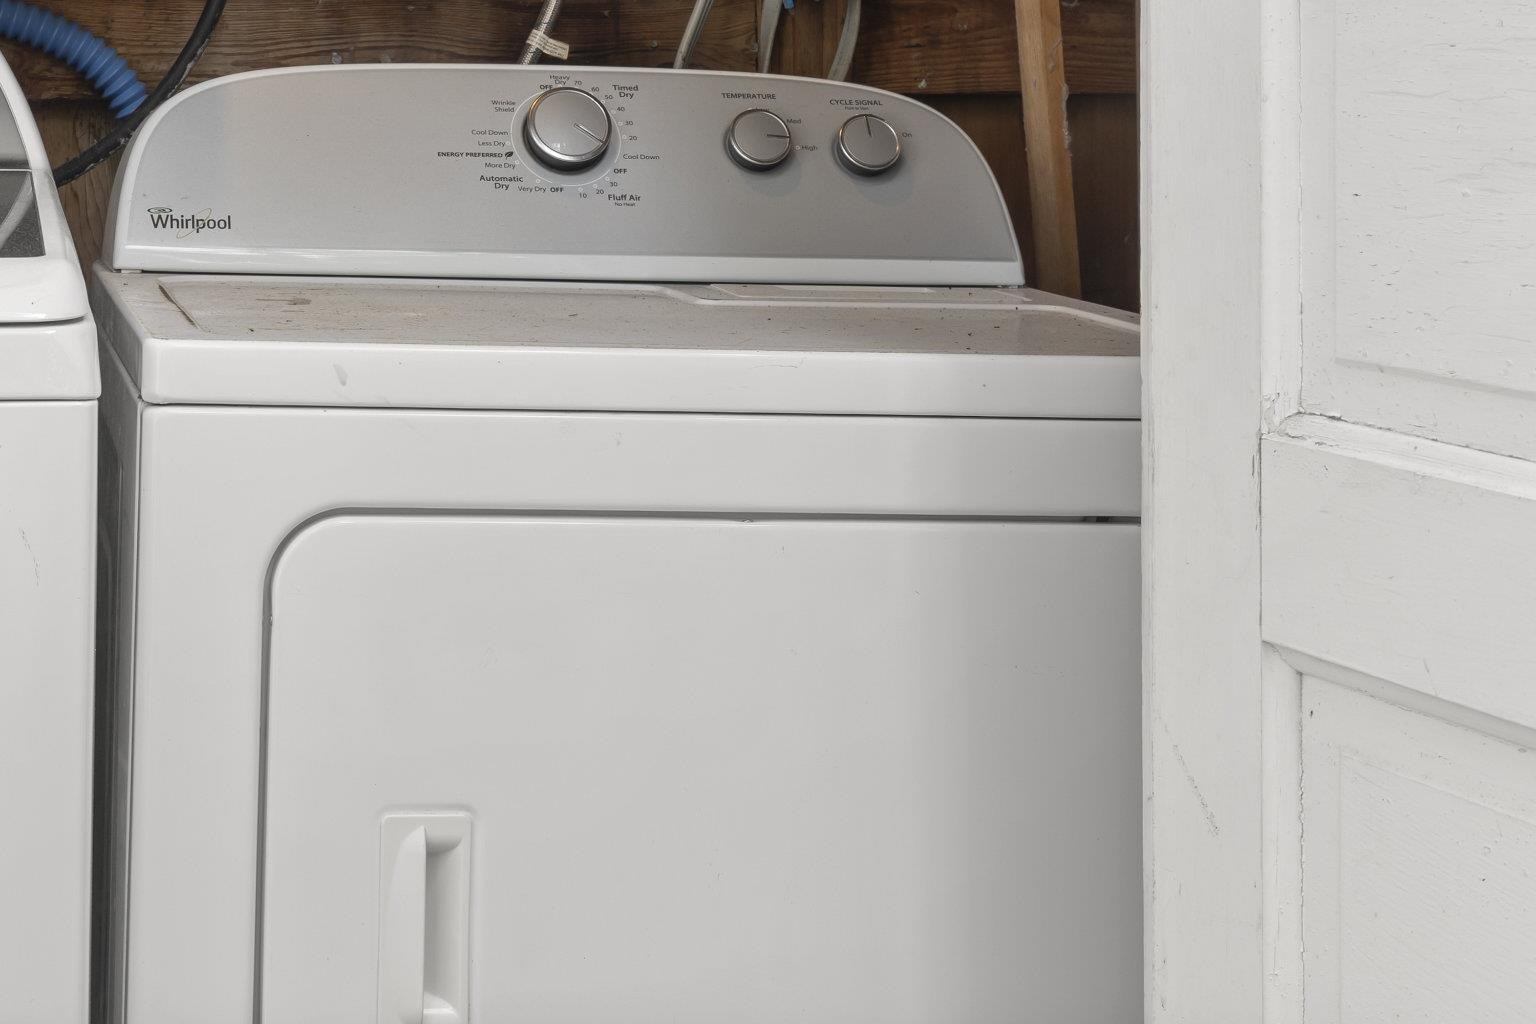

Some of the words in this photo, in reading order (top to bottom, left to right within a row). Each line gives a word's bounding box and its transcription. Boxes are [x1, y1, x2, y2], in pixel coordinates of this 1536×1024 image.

[612, 84, 639, 92] Timed
[618, 91, 635, 100] Dry
[721, 92, 776, 100] TEMPERATURE
[854, 99, 883, 107] SIGNAL
[494, 140, 506, 148] Dry
[484, 161, 502, 169] More
[503, 162, 516, 170] Dry
[479, 174, 524, 183] Automatic
[494, 182, 510, 191] Dry
[517, 185, 533, 193] Very
[534, 185, 547, 193] Dry
[607, 193, 626, 201] Fluff
[627, 193, 642, 201] Air
[149, 214, 232, 234] Whirlpool
